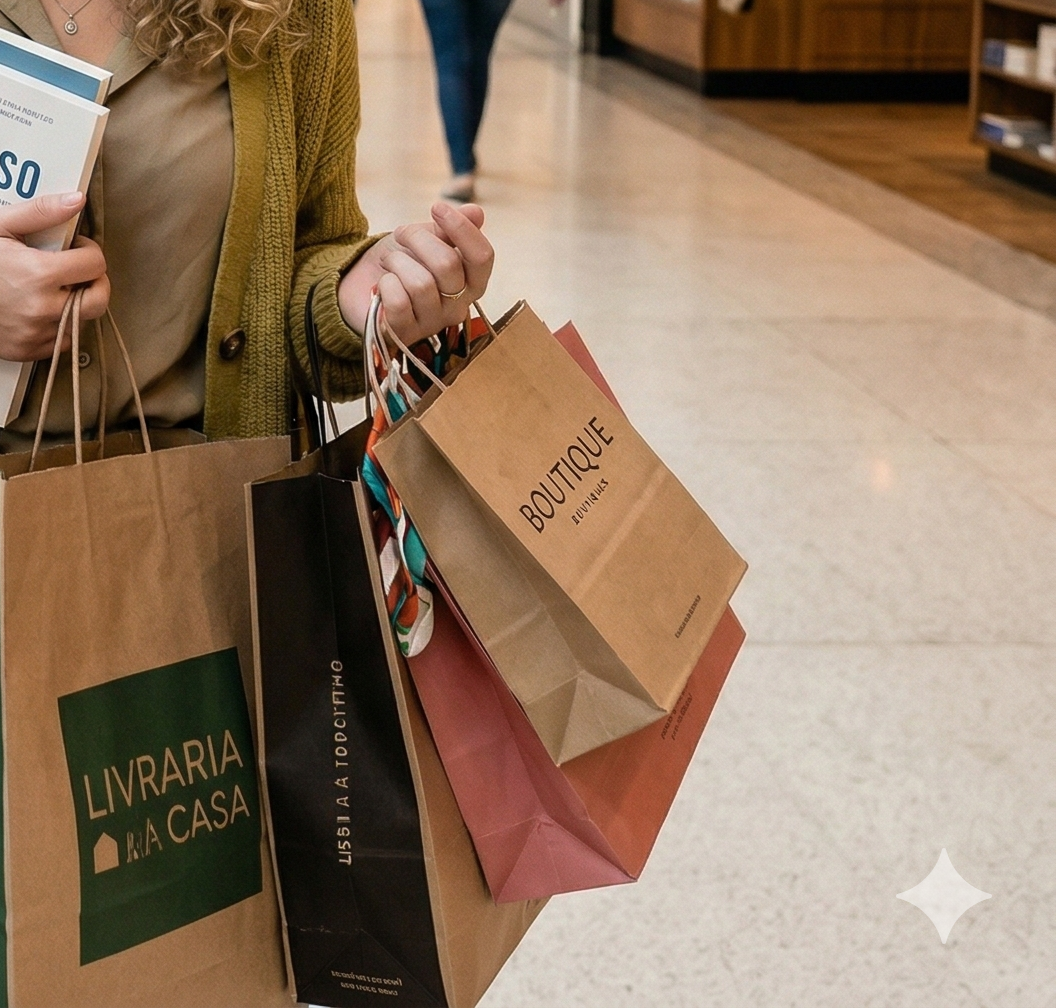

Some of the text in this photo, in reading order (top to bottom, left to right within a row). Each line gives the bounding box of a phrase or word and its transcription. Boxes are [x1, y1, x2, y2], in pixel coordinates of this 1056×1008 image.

[519, 416, 615, 535] BOUTIQUE
[83, 728, 244, 821] LIVRARIA
[166, 784, 251, 844] CASA
